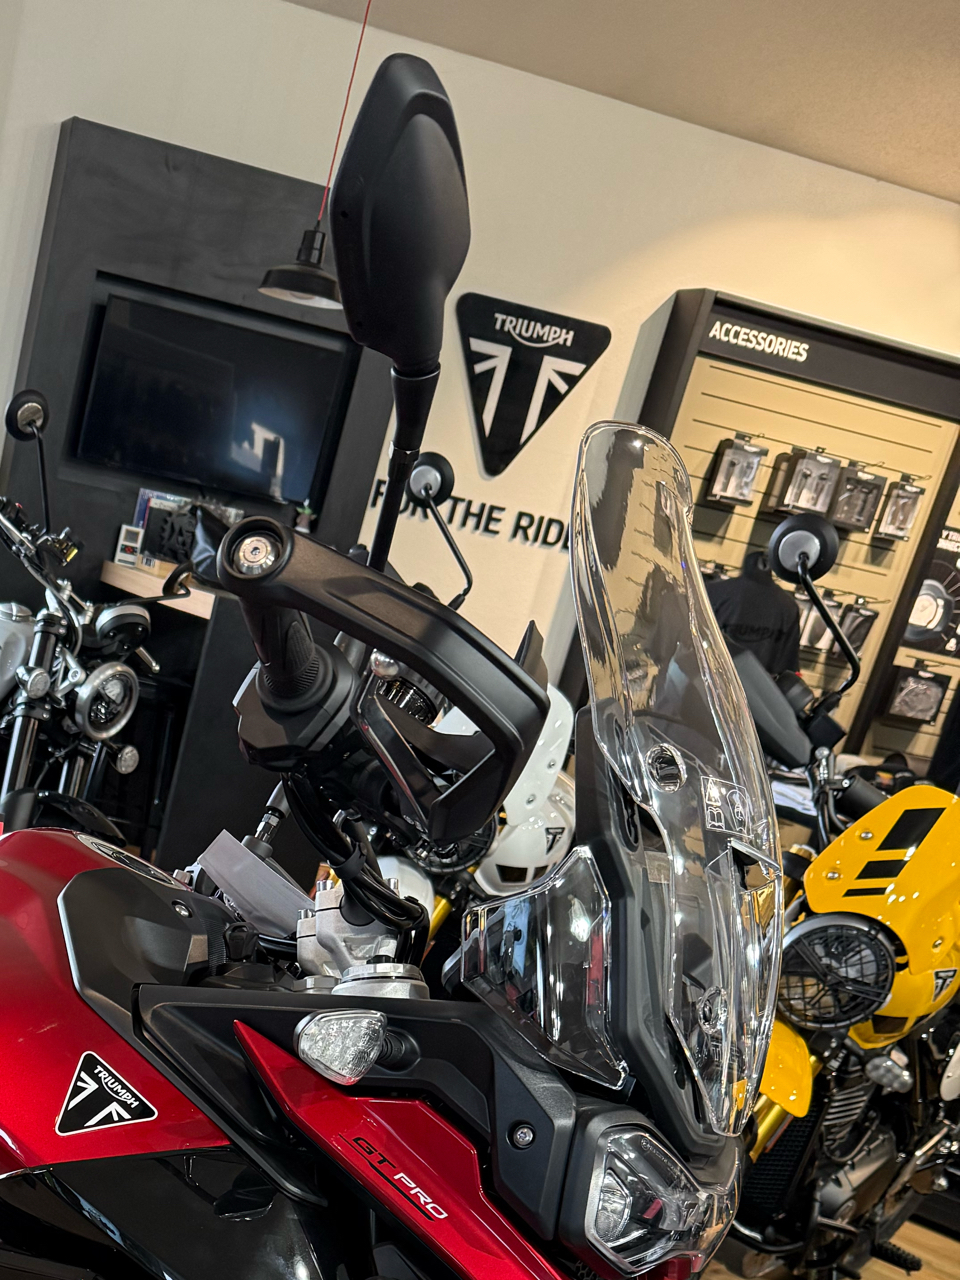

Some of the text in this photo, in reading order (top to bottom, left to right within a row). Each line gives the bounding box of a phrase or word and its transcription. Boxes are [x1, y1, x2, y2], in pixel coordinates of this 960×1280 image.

[494, 312, 575, 347] TRIUMPH
[709, 321, 809, 362] ACCESSORIES
[448, 495, 506, 535] THE
[94, 1065, 139, 1108] TRIUMPH
[352, 1137, 448, 1219] GT PRO
